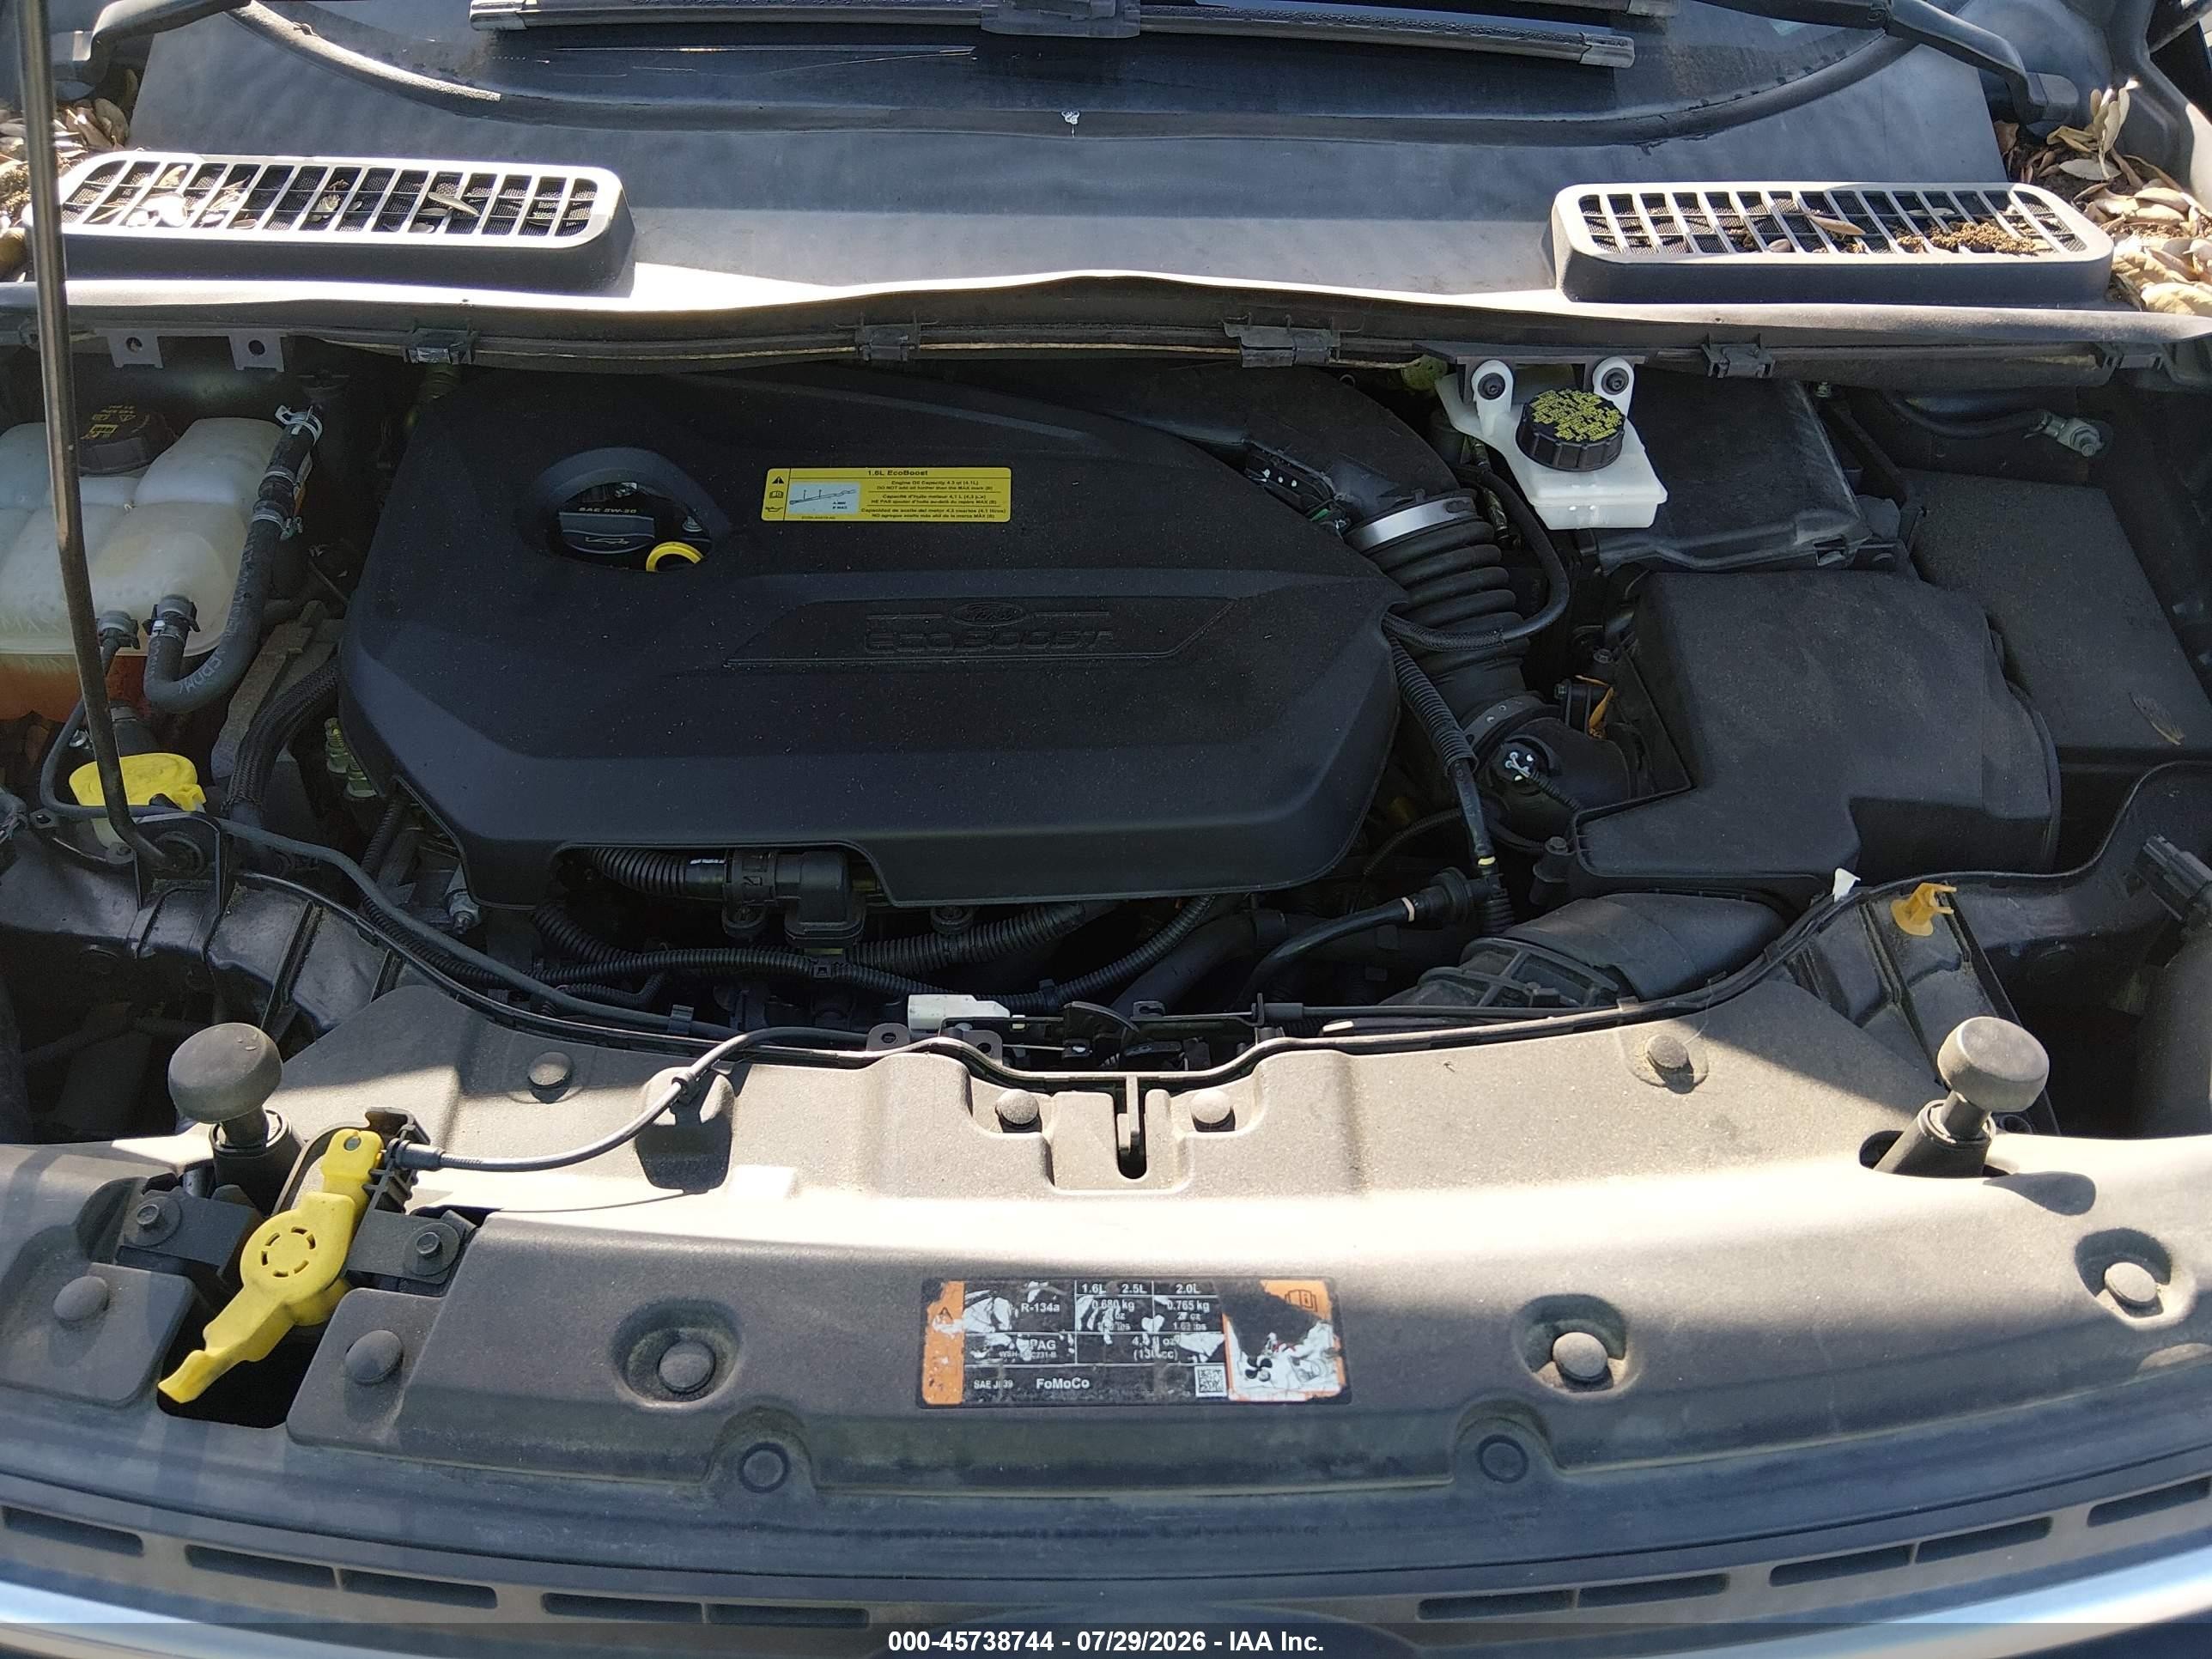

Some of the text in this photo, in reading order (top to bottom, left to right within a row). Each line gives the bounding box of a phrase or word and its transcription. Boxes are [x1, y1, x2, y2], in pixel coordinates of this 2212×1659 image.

[1082, 1283, 1148, 1294] 1.6L 2.5L
[1176, 1283, 1201, 1294] 2.0L
[1020, 1302, 1060, 1314] R-134a
[1121, 1298, 1135, 1313] kg
[1167, 1299, 1211, 1313] 0.765 kg
[1193, 1321, 1207, 1331] lbs
[1030, 1338, 1057, 1351] PAG
[973, 1379, 992, 1389] SAE
[1036, 1376, 1091, 1390] FoMoCo
